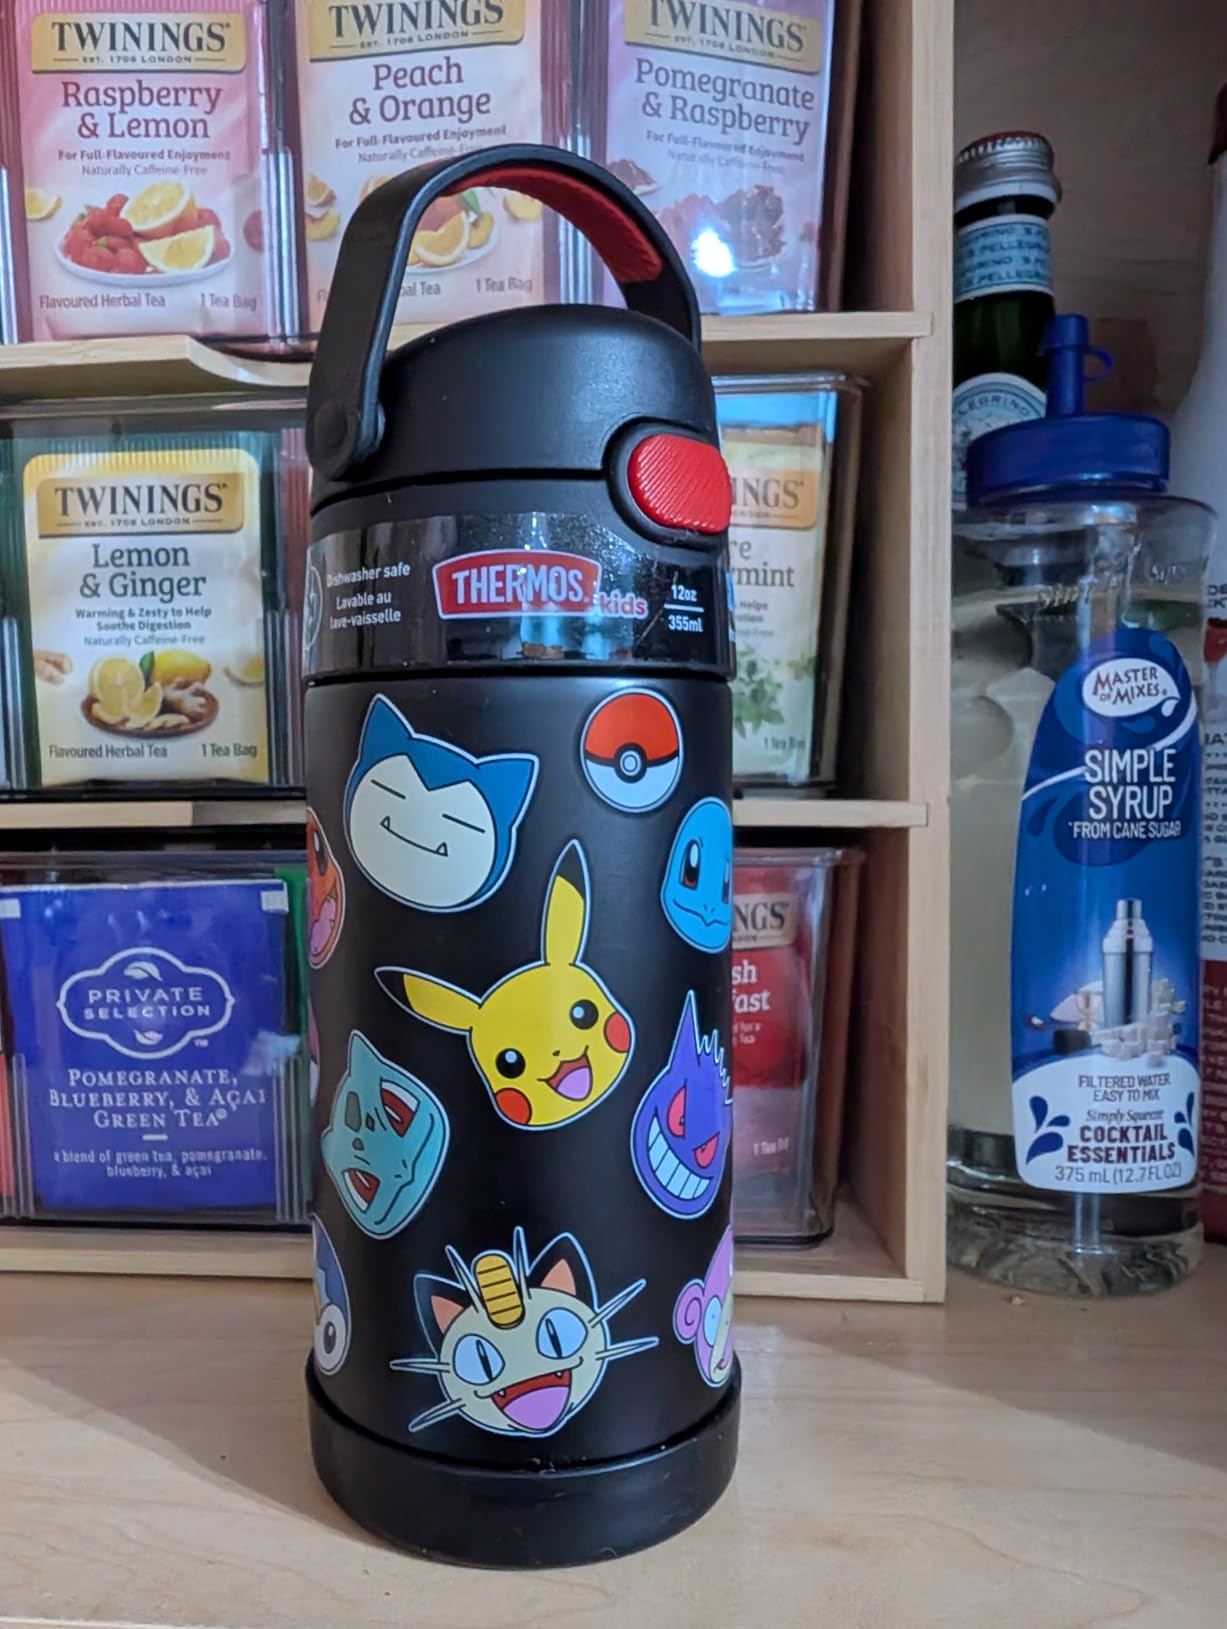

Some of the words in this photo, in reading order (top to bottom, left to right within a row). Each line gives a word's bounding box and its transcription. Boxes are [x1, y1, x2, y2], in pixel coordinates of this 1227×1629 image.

[329, 0, 504, 38] TWININGS
[650, 0, 807, 52] TWININGS
[51, 22, 226, 52] TWININGS
[418, 31, 469, 42] LONDON
[141, 56, 193, 64] LONDON
[373, 57, 464, 90] Peach
[635, 58, 815, 110] Pomegranate
[61, 80, 223, 114] Raspberry
[349, 98, 371, 125] &
[379, 92, 491, 124] Orange
[78, 114, 99, 138] &
[108, 113, 210, 139] Lemon
[642, 92, 662, 118] &
[670, 95, 811, 146] Raspberry
[335, 138, 355, 149] For
[443, 125, 507, 143] Enjoyment
[58, 150, 78, 160] For
[167, 150, 230, 162] Enjoyment
[358, 149, 408, 163] Naturally
[82, 164, 131, 177] Naturally
[420, 281, 441, 295] Tea
[485, 278, 505, 292] Tea
[508, 276, 533, 293] Bag
[40, 295, 98, 310] Flavoured
[101, 294, 143, 309] Herbal
[145, 294, 166, 308] Tea
[209, 295, 230, 309] Tea
[233, 296, 258, 311] Bag
[55, 483, 223, 517] TWININGS
[731, 478, 800, 510] INGS
[140, 517, 191, 527] LONDON
[92, 543, 190, 569] Lemon
[327, 566, 382, 588] Dishwasher
[383, 561, 411, 578] safe
[80, 573, 101, 599] &
[109, 571, 207, 603] Ginger
[452, 563, 585, 606] THERMOS
[599, 592, 648, 618] kids
[671, 583, 697, 603] 12oz
[336, 592, 374, 610] Lavable
[376, 592, 391, 604] au
[75, 608, 125, 620] Warming
[128, 608, 135, 618] &
[138, 607, 169, 620] Zesty
[171, 607, 183, 618] to
[185, 606, 212, 619] Help
[330, 608, 401, 629] lave-vaisselle
[96, 621, 135, 631] Soothe
[138, 620, 191, 632] Digestion
[84, 635, 133, 647] Naturally
[1092, 666, 1158, 697] MASTER
[1112, 682, 1160, 705] MIXES
[49, 744, 103, 758] Flavoured
[105, 744, 145, 757] Herbal
[149, 744, 168, 757] Tea
[210, 744, 231, 757] Tea
[234, 743, 258, 758] Bag
[1084, 748, 1176, 783] SIMPLE
[1089, 785, 1173, 820] SYRUP
[1113, 820, 1147, 839] CANE
[1148, 820, 1182, 838] SUGAR
[88, 987, 203, 1004] PRIVATE
[83, 1005, 210, 1020] SELECTION
[68, 1068, 239, 1087] POMEGRANATE,
[1078, 1074, 1135, 1089] FILTERED
[1137, 1073, 1170, 1086] WATER
[49, 1088, 175, 1110] BLUEBERRY,
[185, 1088, 201, 1106] &
[1093, 1089, 1125, 1102] EASY
[1127, 1089, 1140, 1101] TO
[1143, 1088, 1160, 1101] MIX
[93, 1109, 166, 1129] GREEN
[1086, 1109, 1125, 1125] Simply
[1080, 1123, 1168, 1144] COCKTAIL
[62, 1150, 95, 1164] blend
[99, 1150, 111, 1163] of
[115, 1151, 149, 1166] green
[1067, 1142, 1176, 1164] ESSENTIALS
[171, 1163, 181, 1176] &
[1055, 1165, 1085, 1183] 375
[1089, 1166, 1110, 1183] mL
[1112, 1165, 1147, 1185] (12.7
[1148, 1166, 1161, 1181] FL
